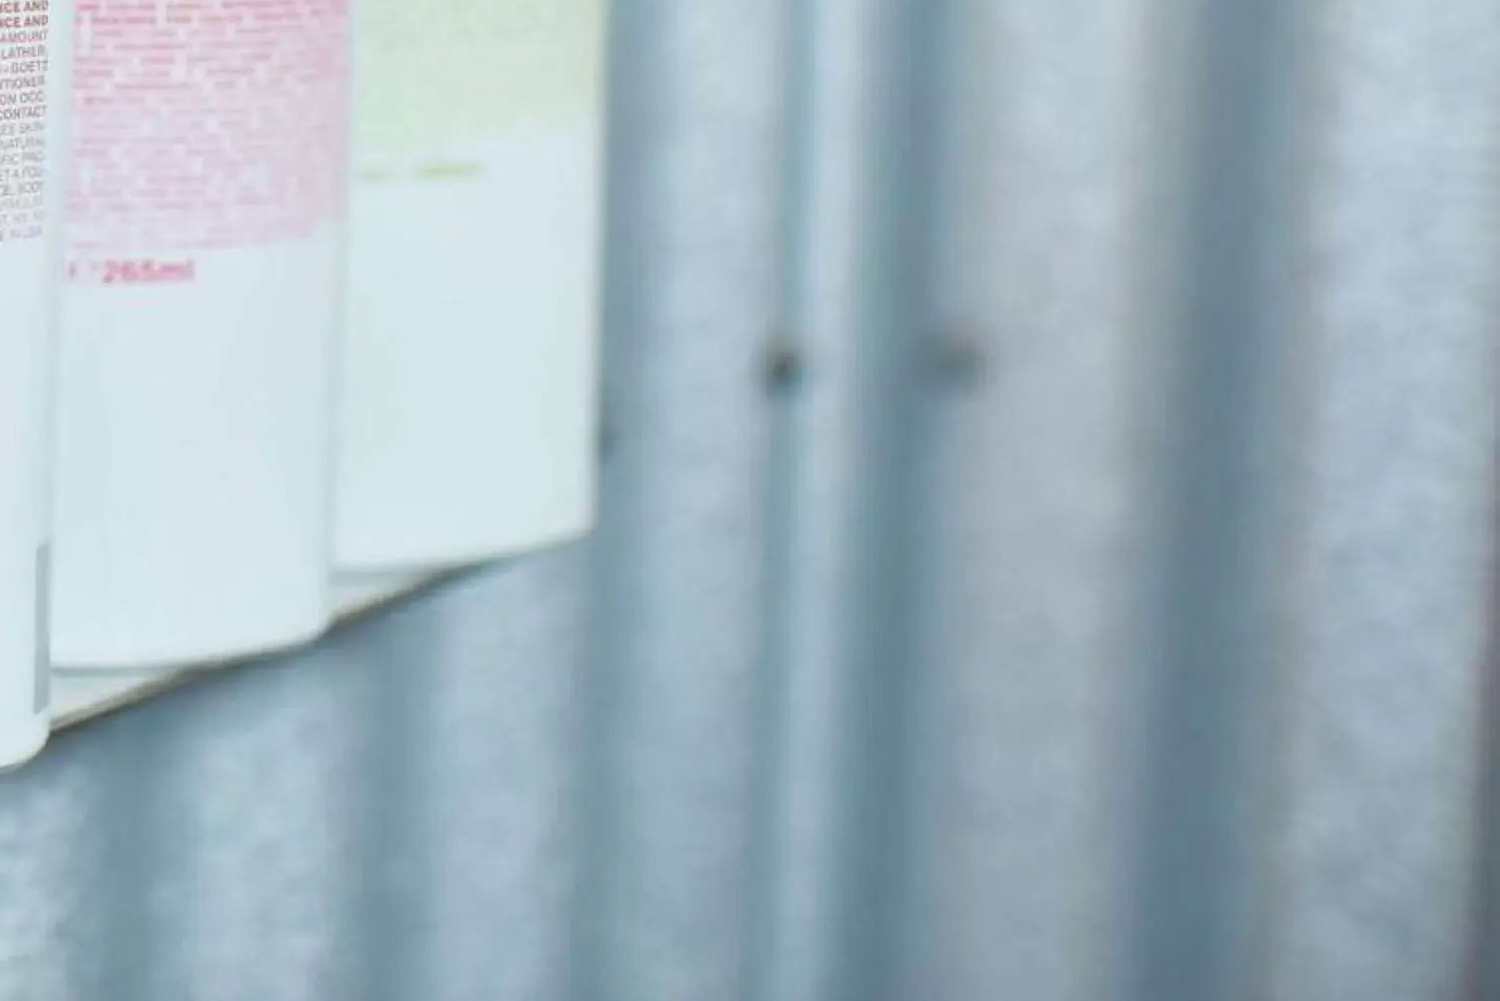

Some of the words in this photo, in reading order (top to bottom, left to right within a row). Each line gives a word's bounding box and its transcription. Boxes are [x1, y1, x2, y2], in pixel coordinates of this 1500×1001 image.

[23, 0, 49, 12] AND
[23, 14, 49, 27] AND
[0, 29, 49, 44] AMOUNT
